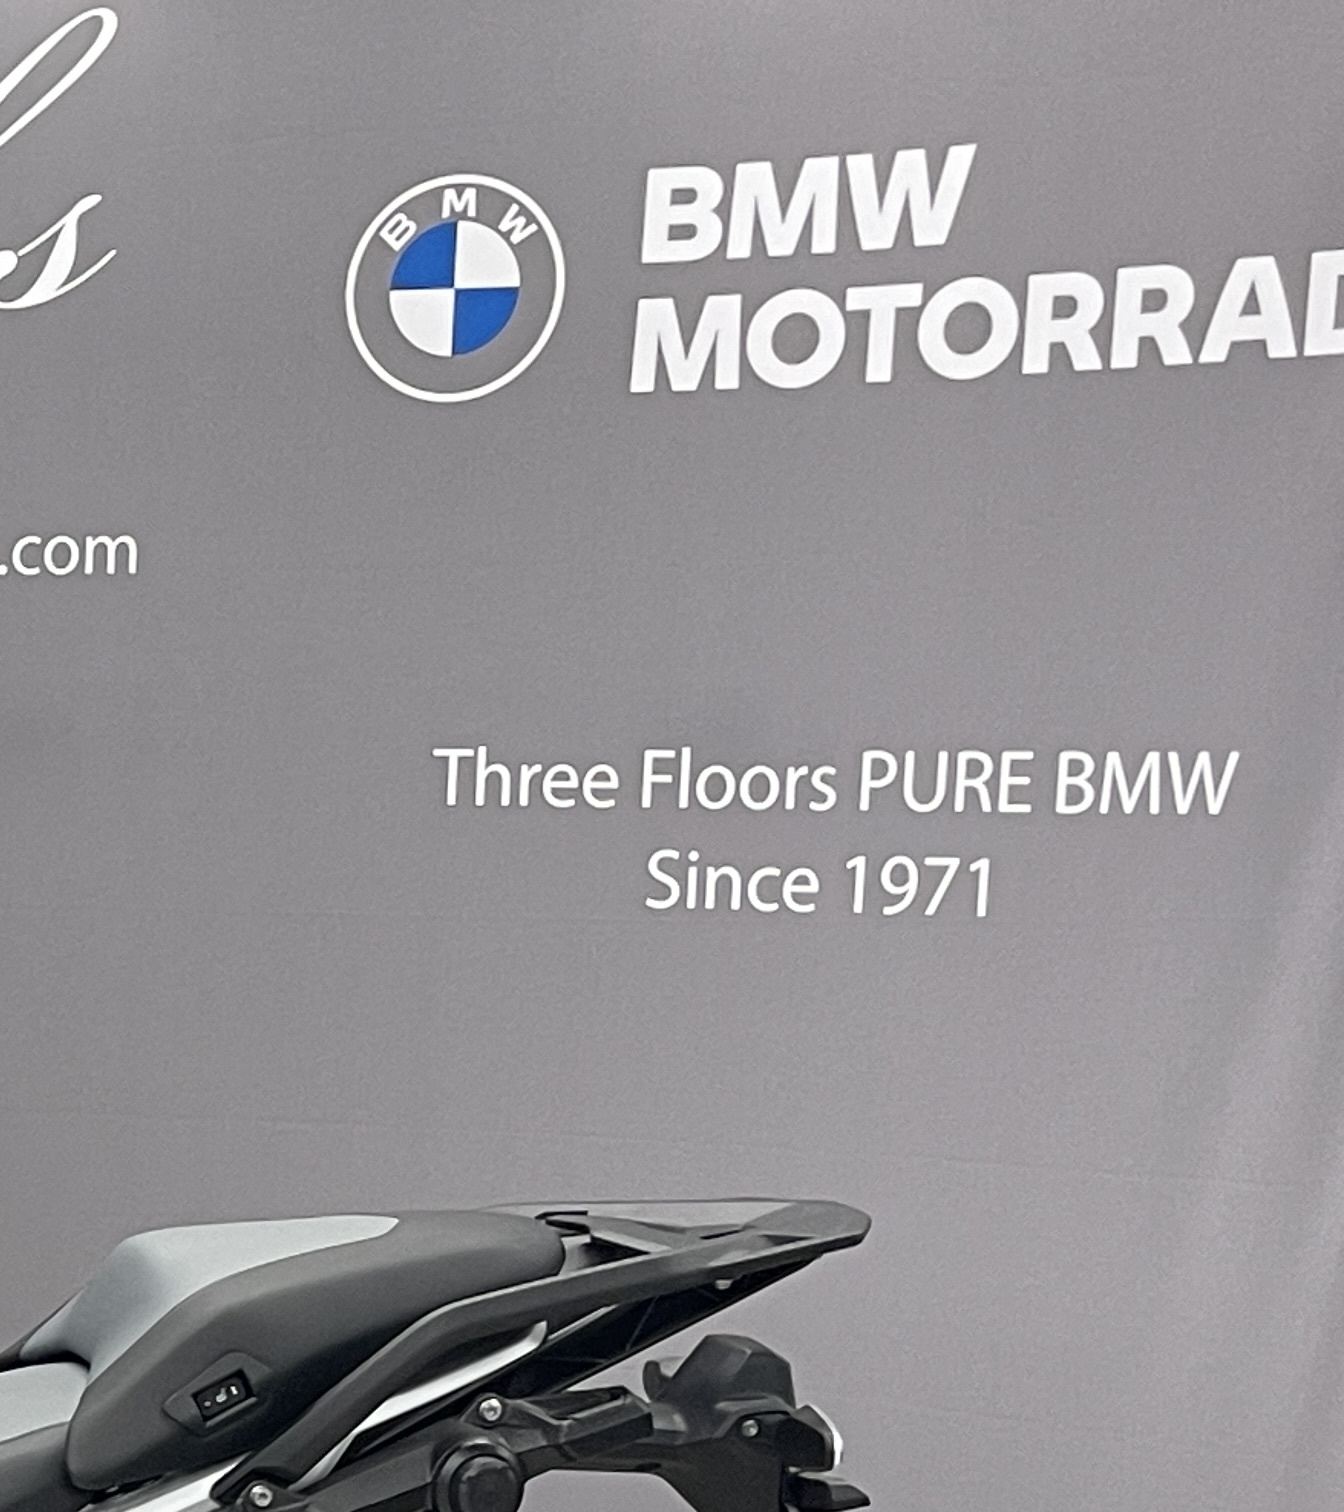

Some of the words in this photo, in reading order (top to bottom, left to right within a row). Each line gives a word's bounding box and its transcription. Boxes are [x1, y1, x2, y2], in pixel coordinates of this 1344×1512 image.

[379, 188, 538, 251] BMW
[642, 144, 977, 263] BMW
[433, 746, 619, 808] Three
[642, 747, 836, 811] Floors
[860, 749, 1034, 813] PURE
[1056, 750, 1240, 815] BMW
[646, 848, 819, 912] Since
[846, 855, 990, 917] 1971
